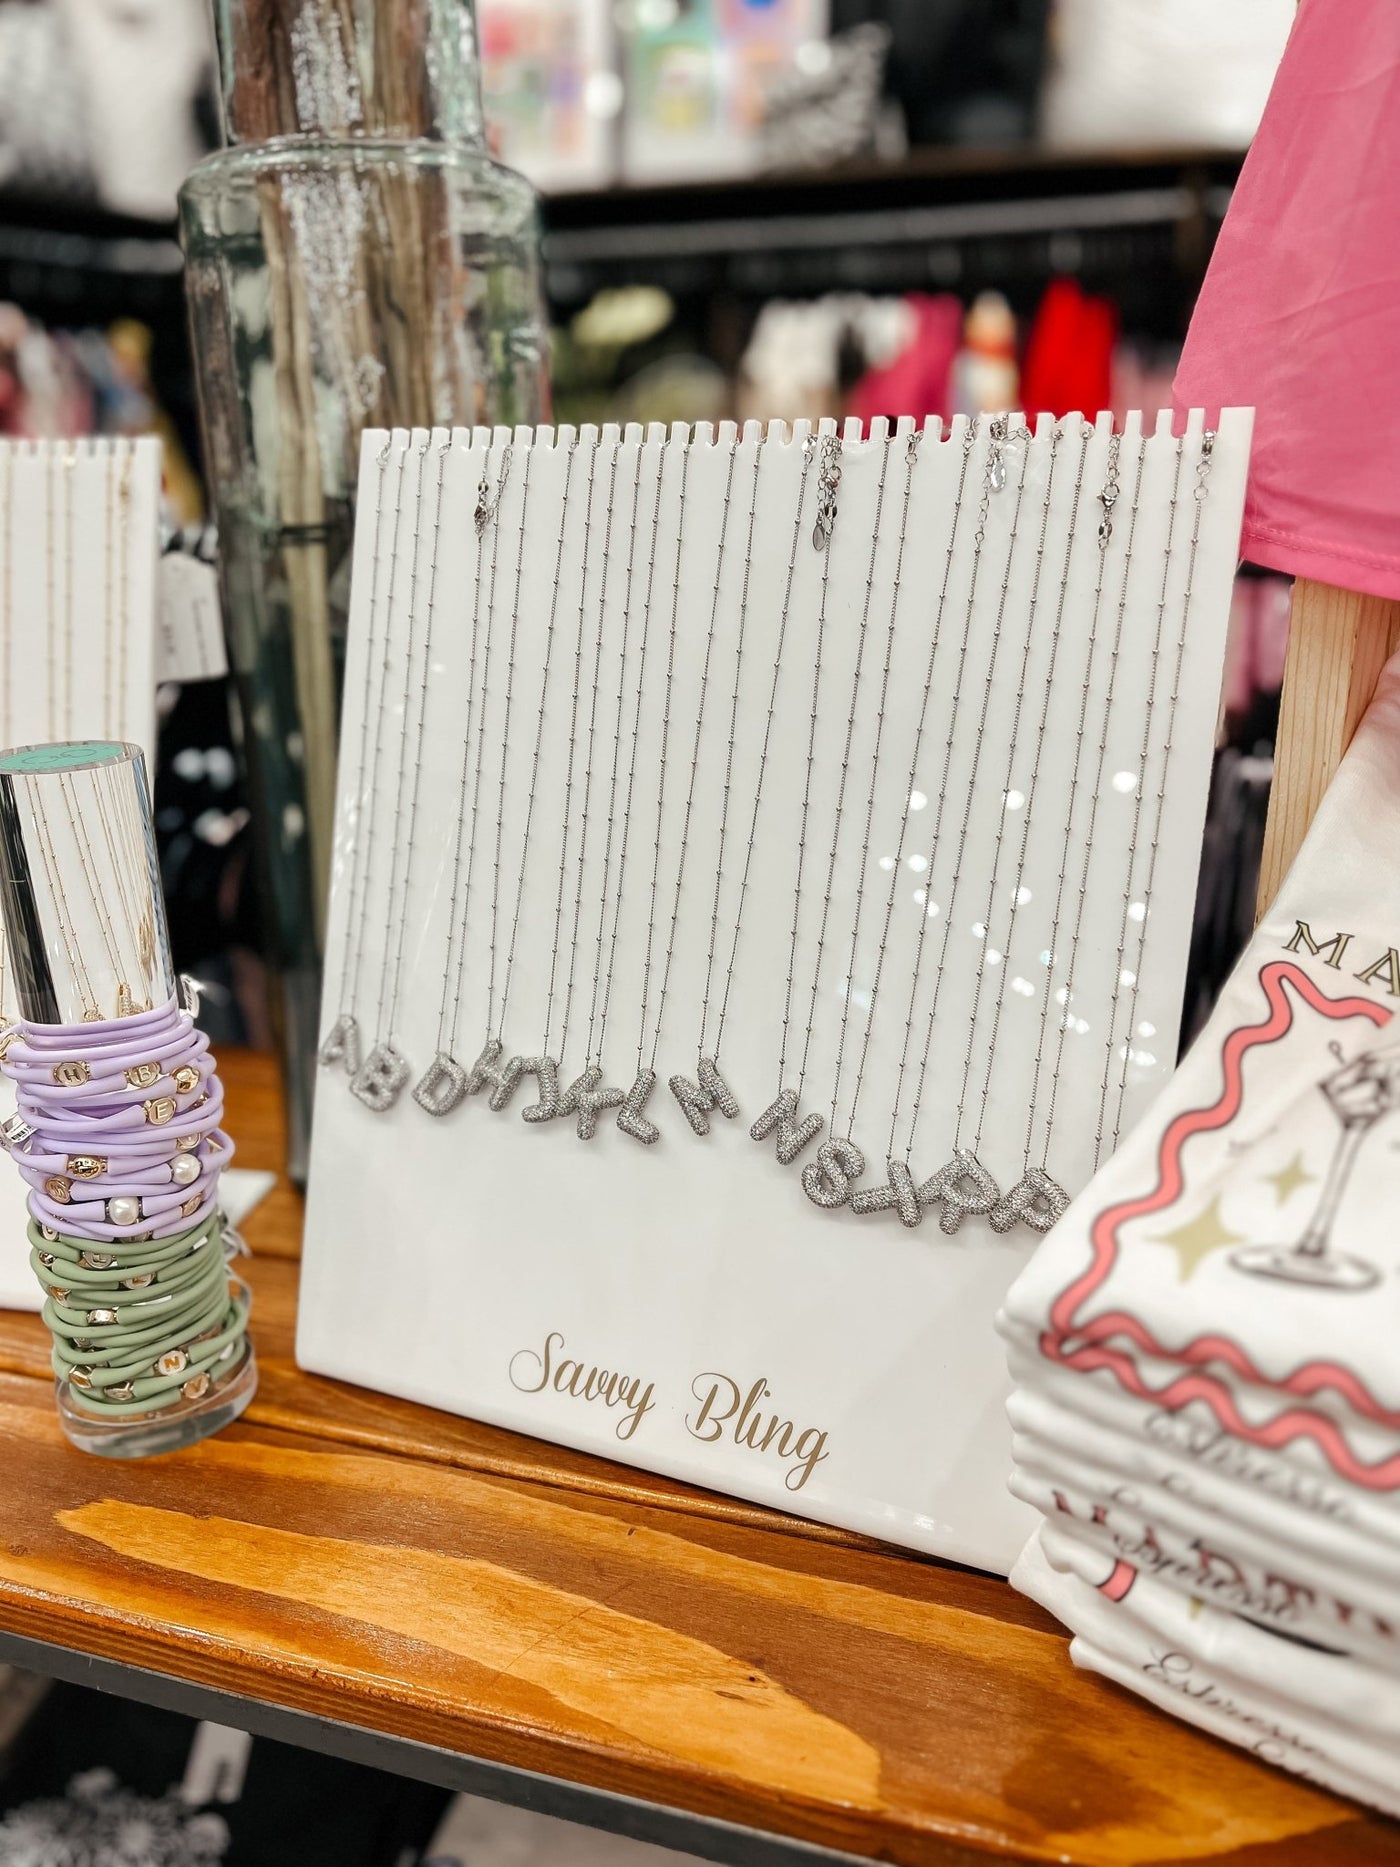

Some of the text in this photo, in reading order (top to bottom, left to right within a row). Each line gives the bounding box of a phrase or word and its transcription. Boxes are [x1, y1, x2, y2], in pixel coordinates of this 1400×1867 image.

[156, 1102, 169, 1119] E
[349, 1044, 411, 1111] B
[412, 1051, 467, 1116] D
[556, 1065, 625, 1140] K
[616, 1068, 660, 1145] L
[668, 1056, 739, 1136] M
[750, 1088, 824, 1165] N
[801, 1137, 866, 1209] S
[509, 1332, 830, 1491] Savvy Bling
